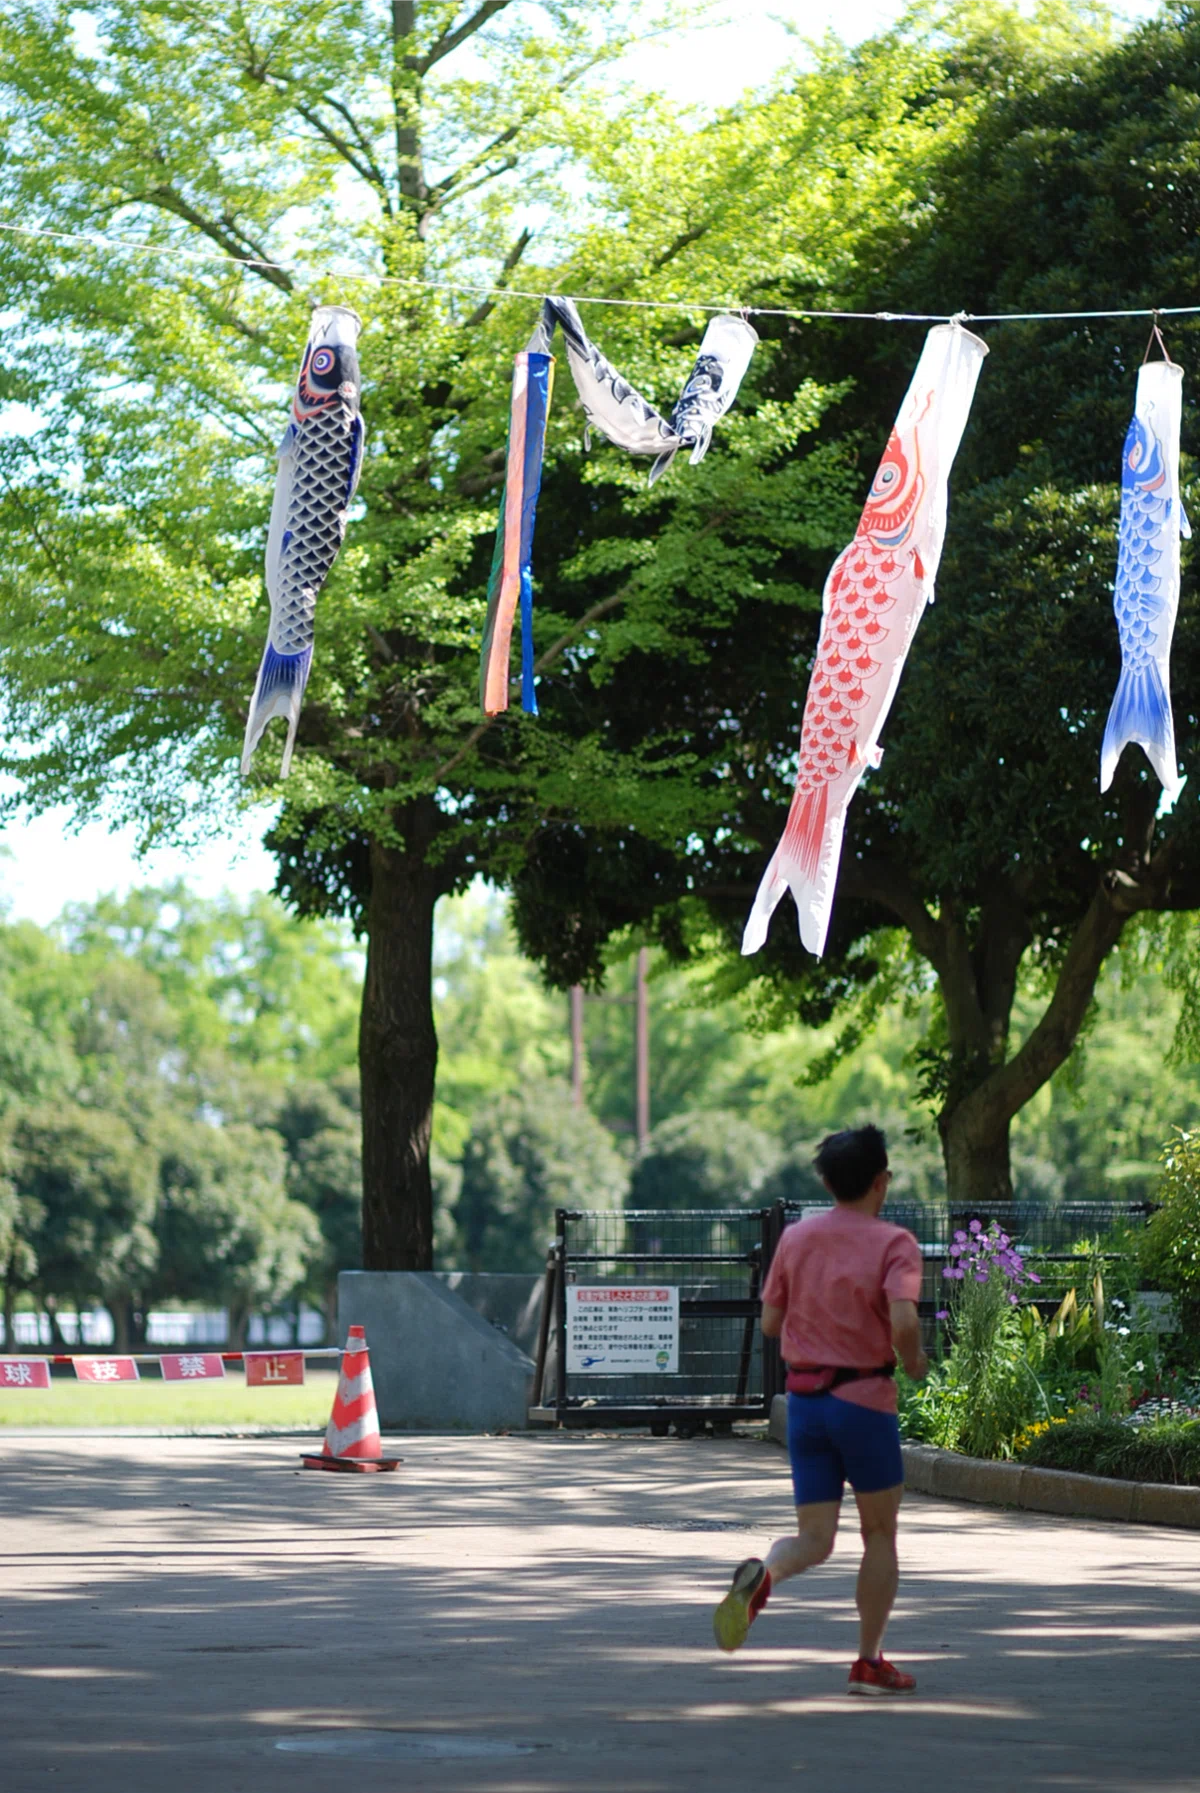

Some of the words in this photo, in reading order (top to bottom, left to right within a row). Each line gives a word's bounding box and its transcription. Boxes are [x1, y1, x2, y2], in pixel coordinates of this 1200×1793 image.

[4, 1363, 32, 1385] 球
[91, 1361, 121, 1380] 技
[177, 1356, 206, 1376] 禁
[262, 1356, 288, 1381] 止
